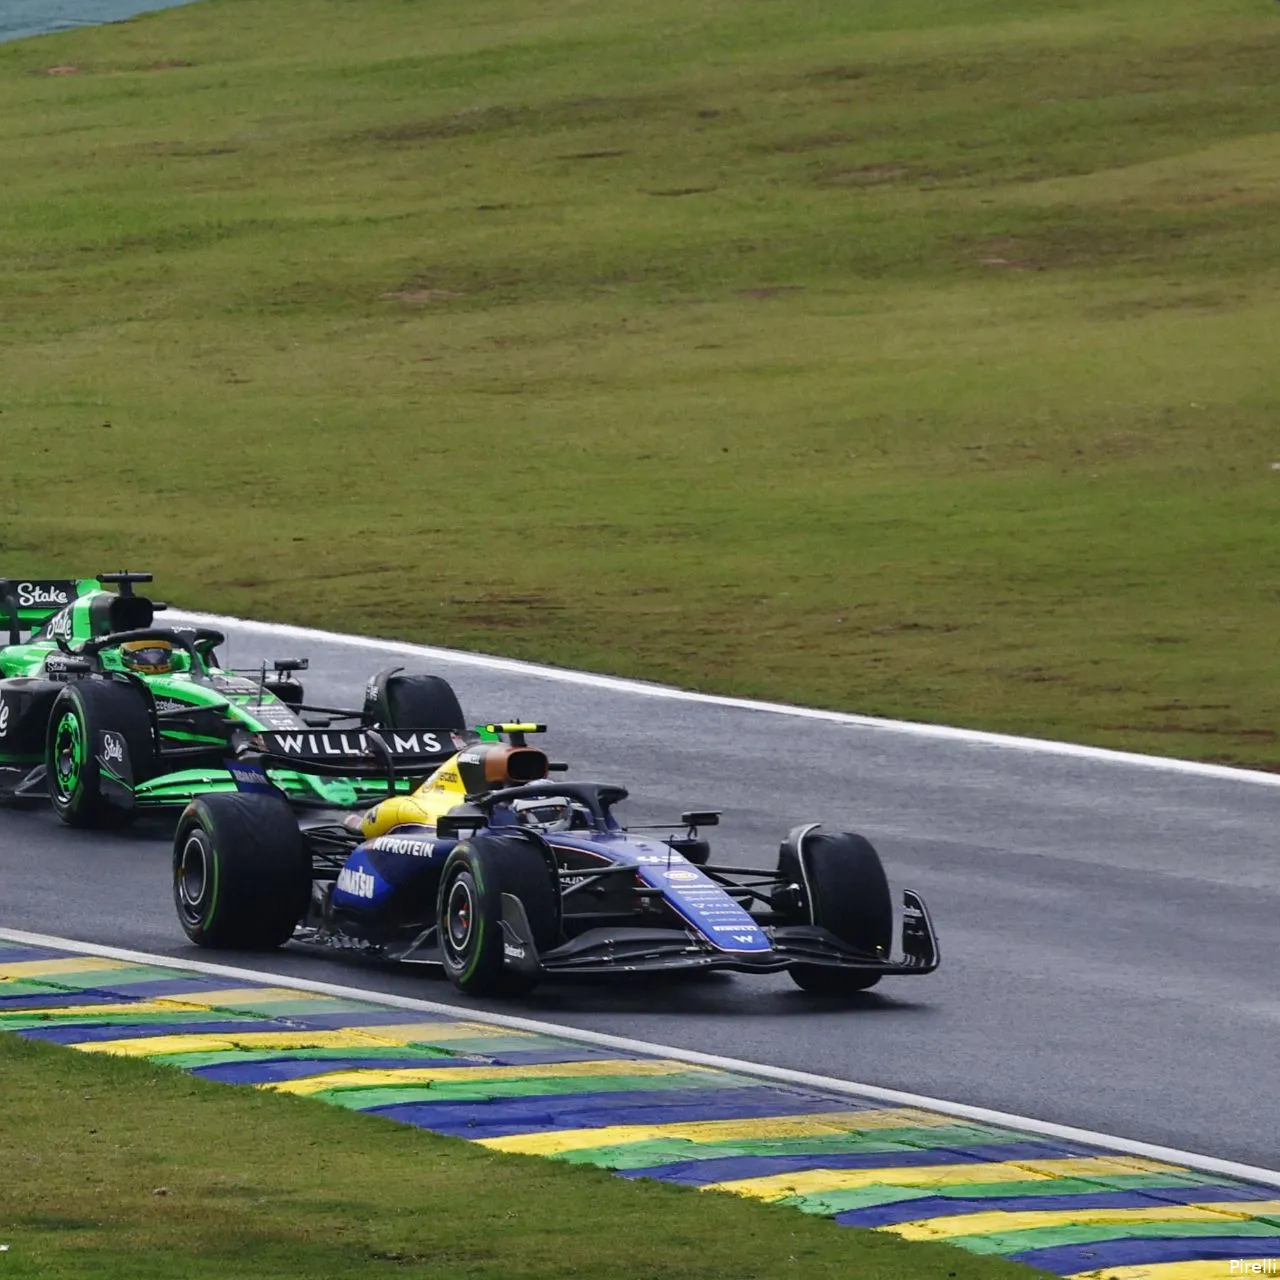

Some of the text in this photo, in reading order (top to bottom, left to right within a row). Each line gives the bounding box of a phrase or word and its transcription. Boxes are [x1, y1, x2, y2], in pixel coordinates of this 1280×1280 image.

[17, 582, 68, 606] Stake
[103, 733, 124, 762] Stake
[274, 732, 443, 755] WILLIMS
[372, 837, 436, 858] MYPROTEIN
[336, 865, 375, 899] OMATSU
